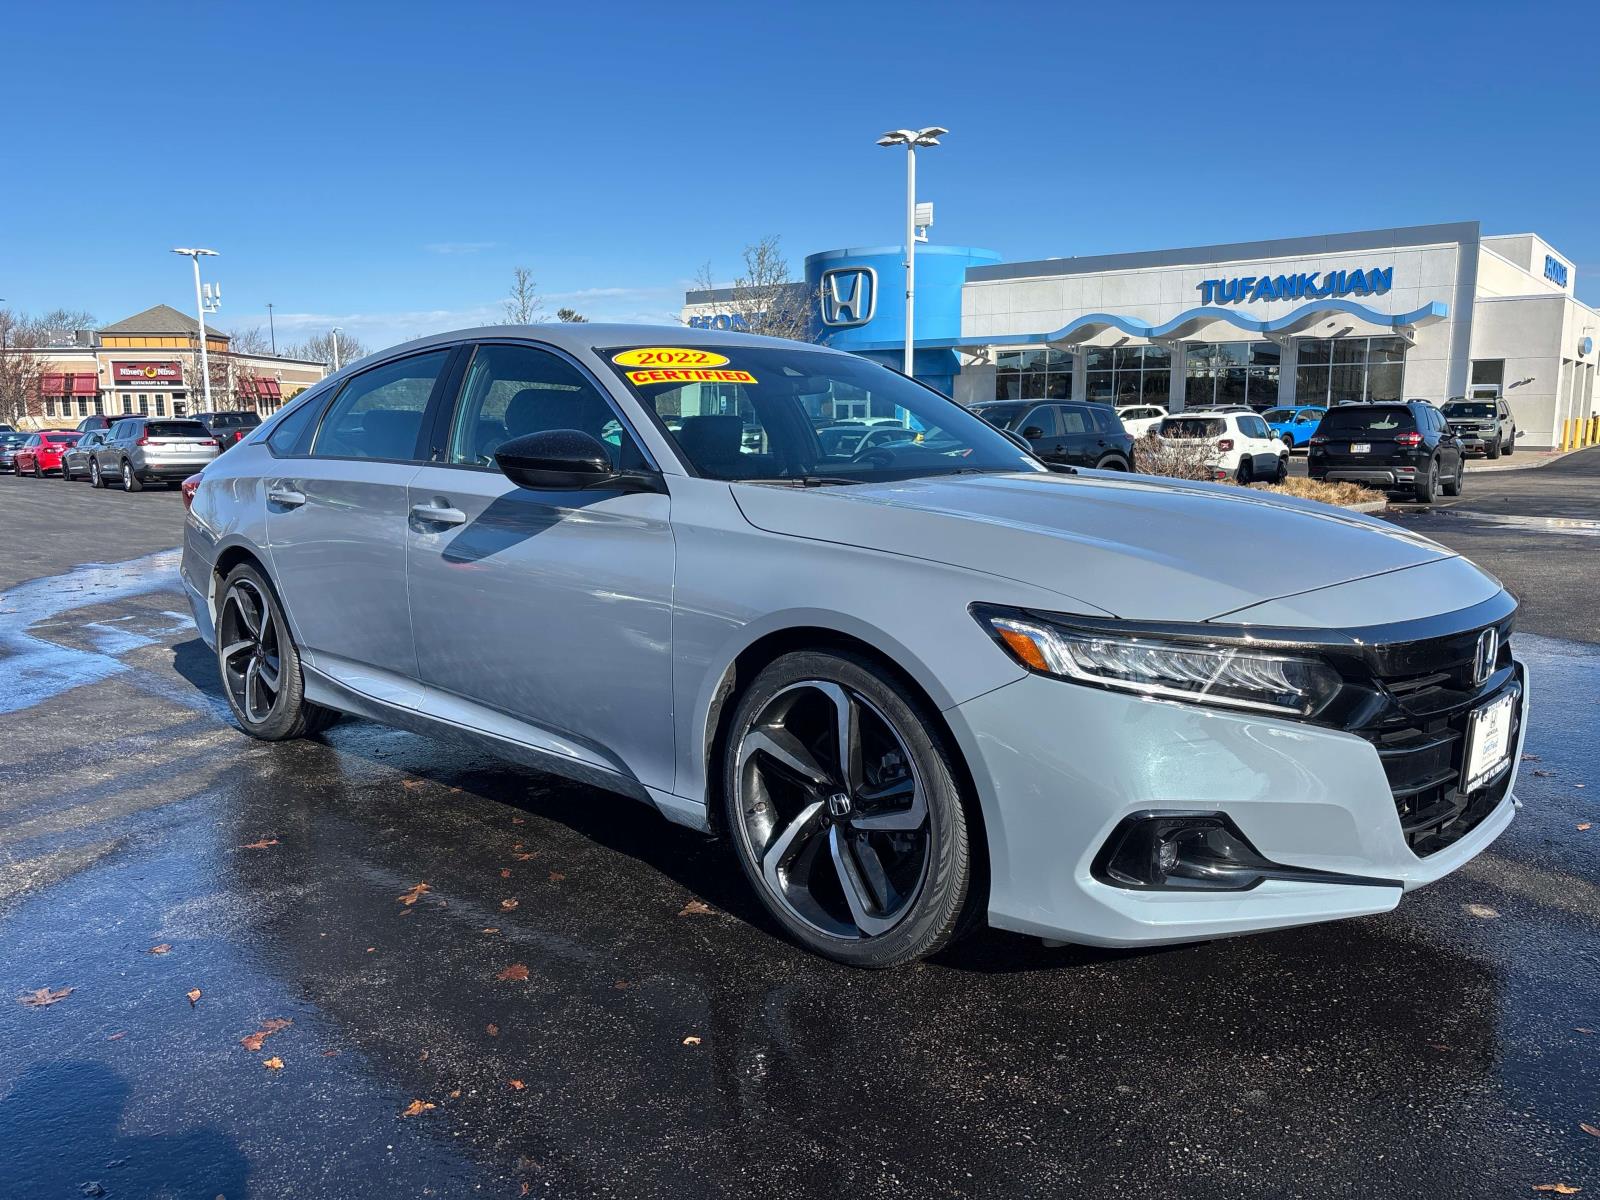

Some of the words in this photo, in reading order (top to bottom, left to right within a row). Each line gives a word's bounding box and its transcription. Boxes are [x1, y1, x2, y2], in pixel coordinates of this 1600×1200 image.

[1544, 254, 1568, 289] HONDA
[1201, 267, 1393, 302] TUFANKJIAN
[637, 352, 710, 365] 2022
[120, 367, 144, 377] Ninety
[157, 367, 176, 376] Nine
[632, 370, 751, 382] CERTIFIED
